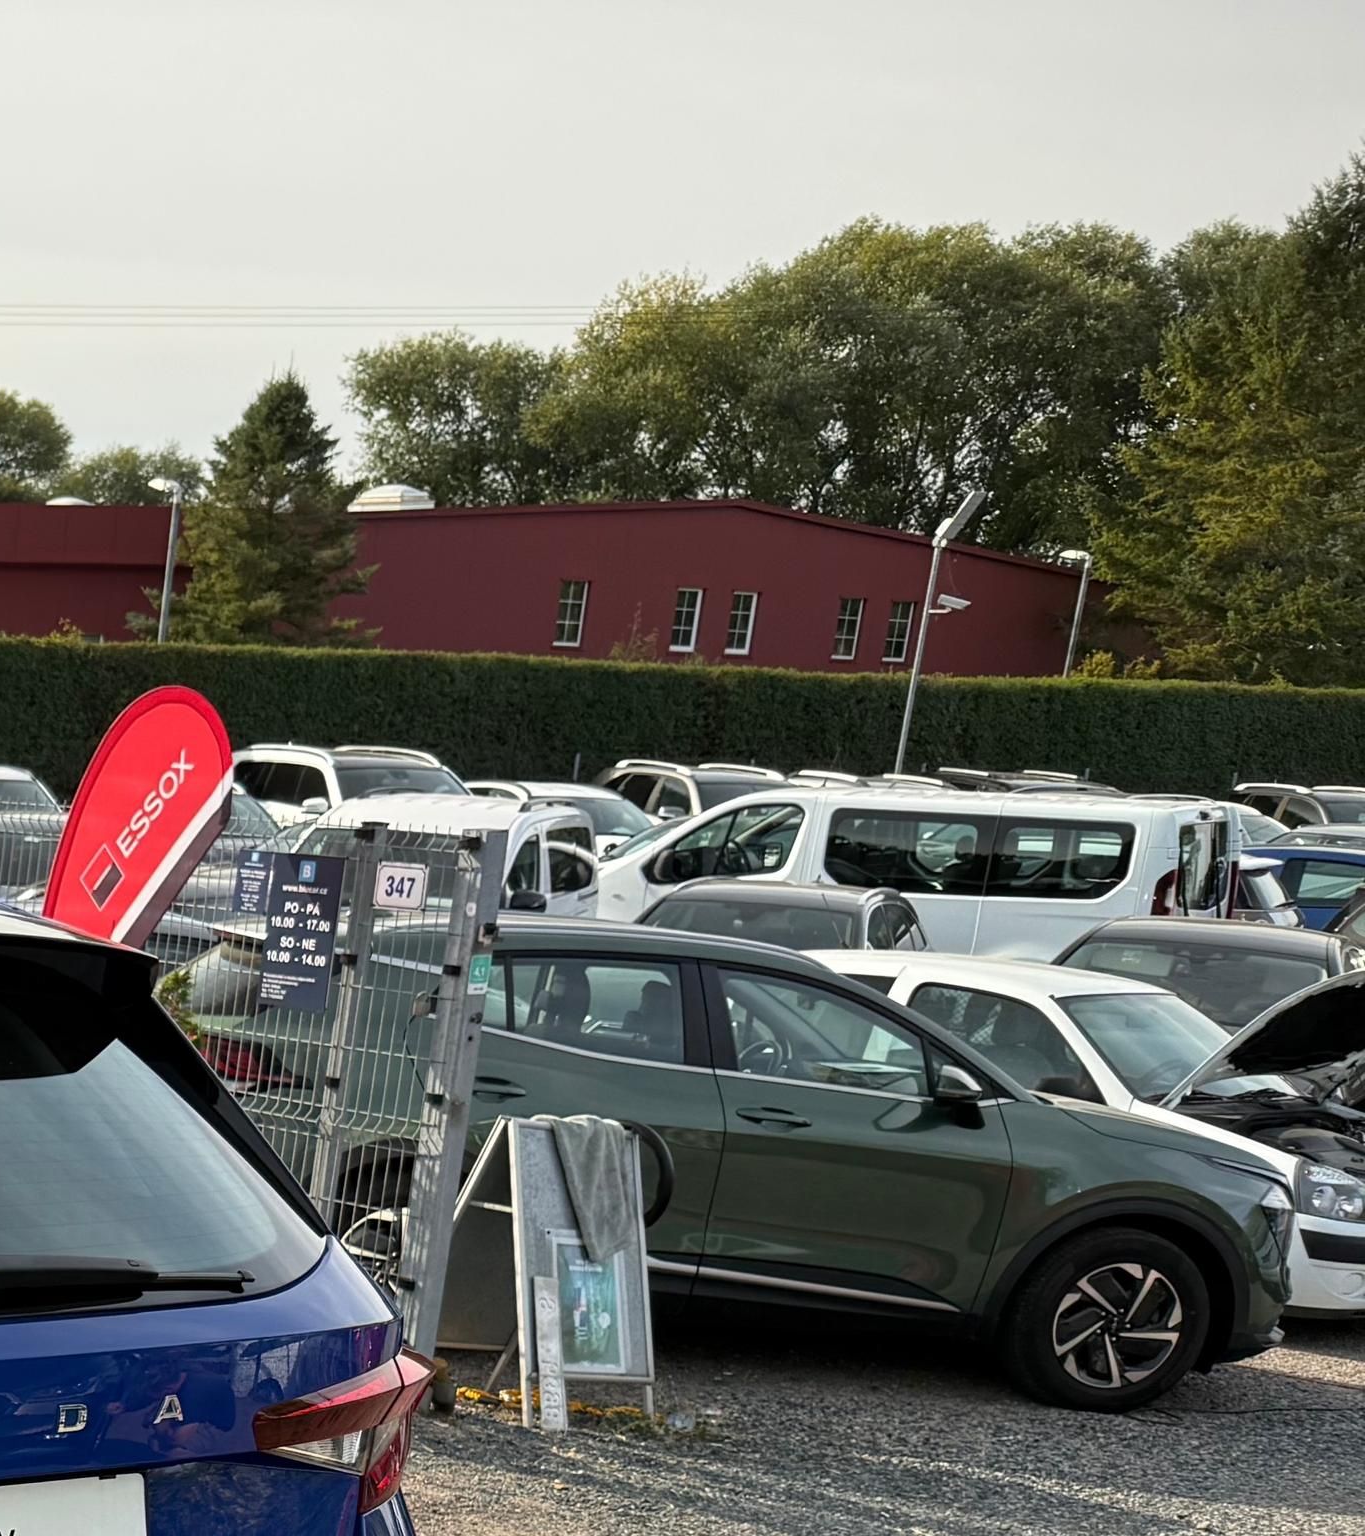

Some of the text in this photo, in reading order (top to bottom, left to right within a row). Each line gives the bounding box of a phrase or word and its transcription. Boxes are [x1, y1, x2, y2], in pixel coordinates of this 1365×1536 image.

[115, 747, 195, 858] ESSOX
[385, 875, 416, 898] 347
[284, 902, 299, 914] PO
[306, 901, 321, 916] PÁ
[271, 916, 295, 928] 10.00
[307, 919, 331, 933] 17.00
[280, 936, 294, 949] SO
[301, 938, 317, 951] NE
[266, 950, 291, 963] 10.00
[301, 953, 326, 967] 14.00
